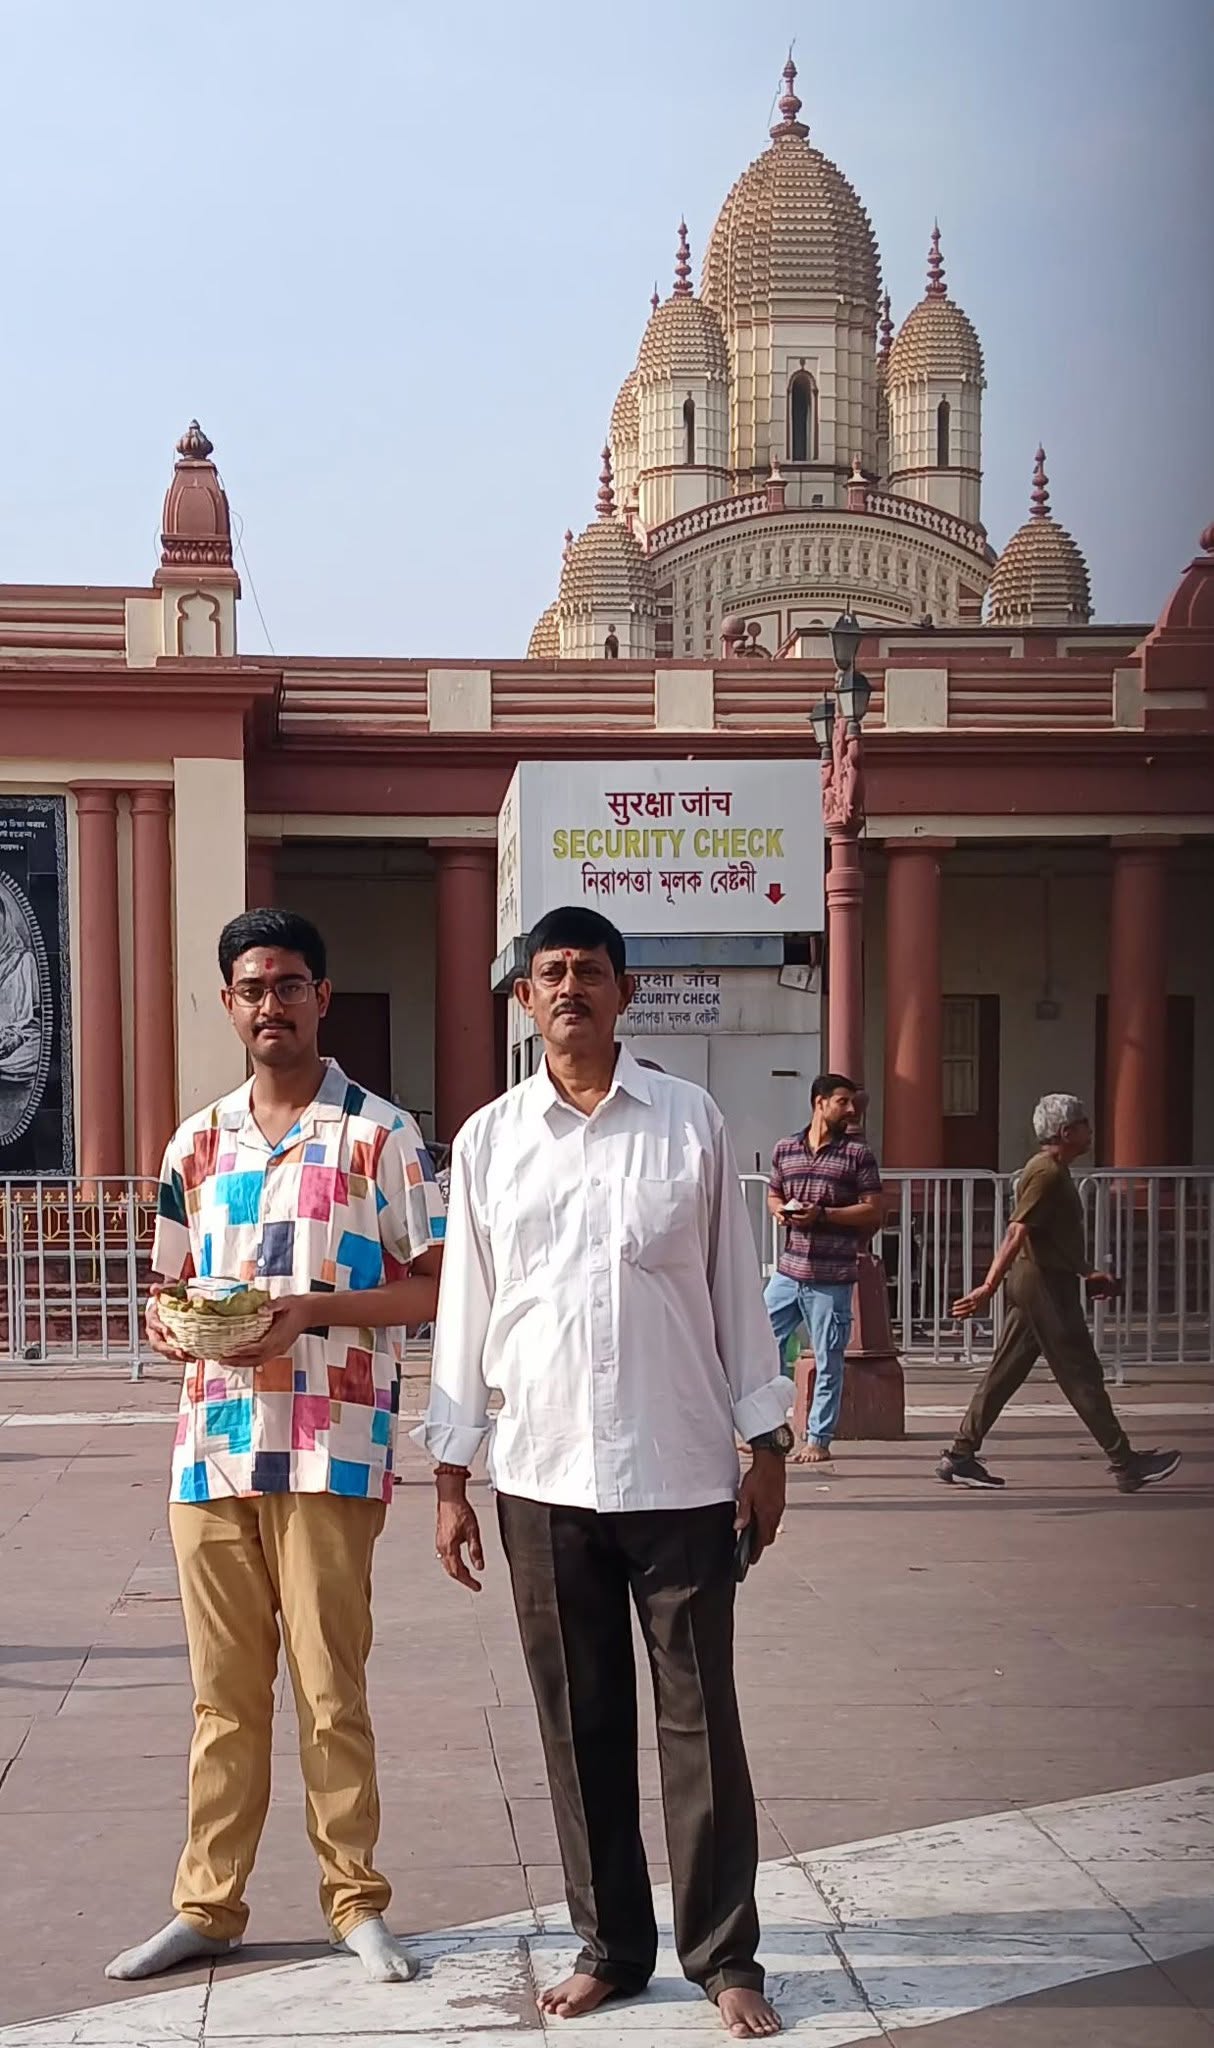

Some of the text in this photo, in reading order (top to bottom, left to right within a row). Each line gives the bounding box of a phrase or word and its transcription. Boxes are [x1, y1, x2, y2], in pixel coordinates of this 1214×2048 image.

[605, 786, 732, 825] सुरक्षा जांच
[553, 828, 785, 859] SECURITY CHECK
[581, 861, 757, 905] নিরাপত্তা মূলক বেষ্টনী
[632, 992, 721, 1005] ECURITY CHECK
